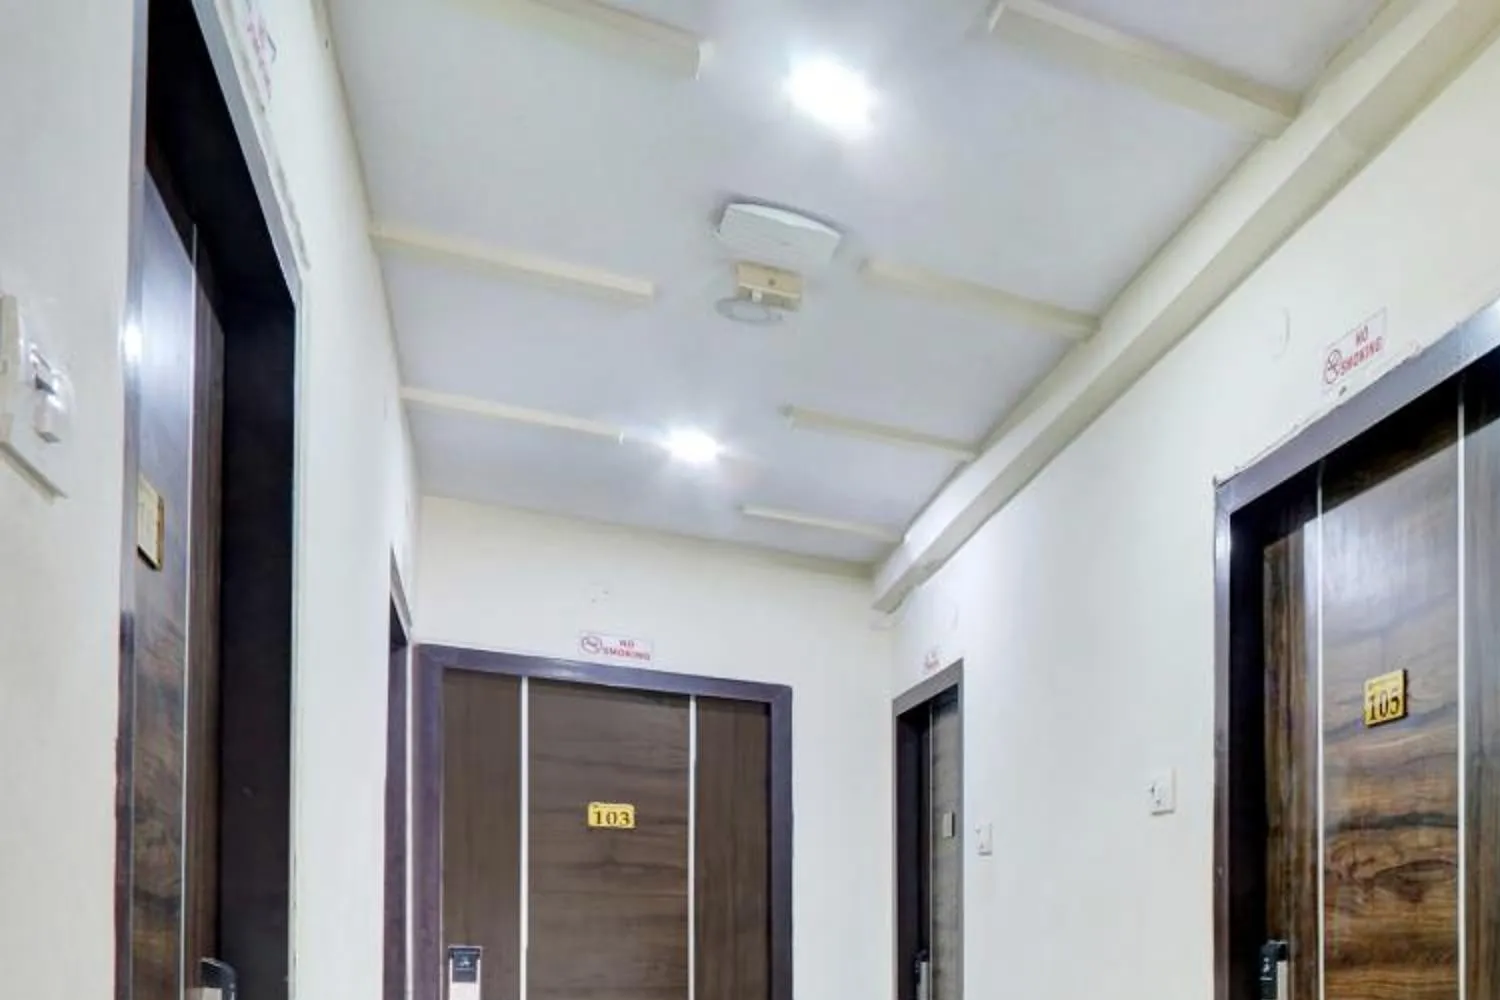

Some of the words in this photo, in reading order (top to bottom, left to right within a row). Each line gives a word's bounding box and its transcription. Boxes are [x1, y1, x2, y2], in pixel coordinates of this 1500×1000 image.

[1356, 325, 1368, 346] NO
[1339, 336, 1382, 376] SMOKING
[592, 811, 631, 825] 103
